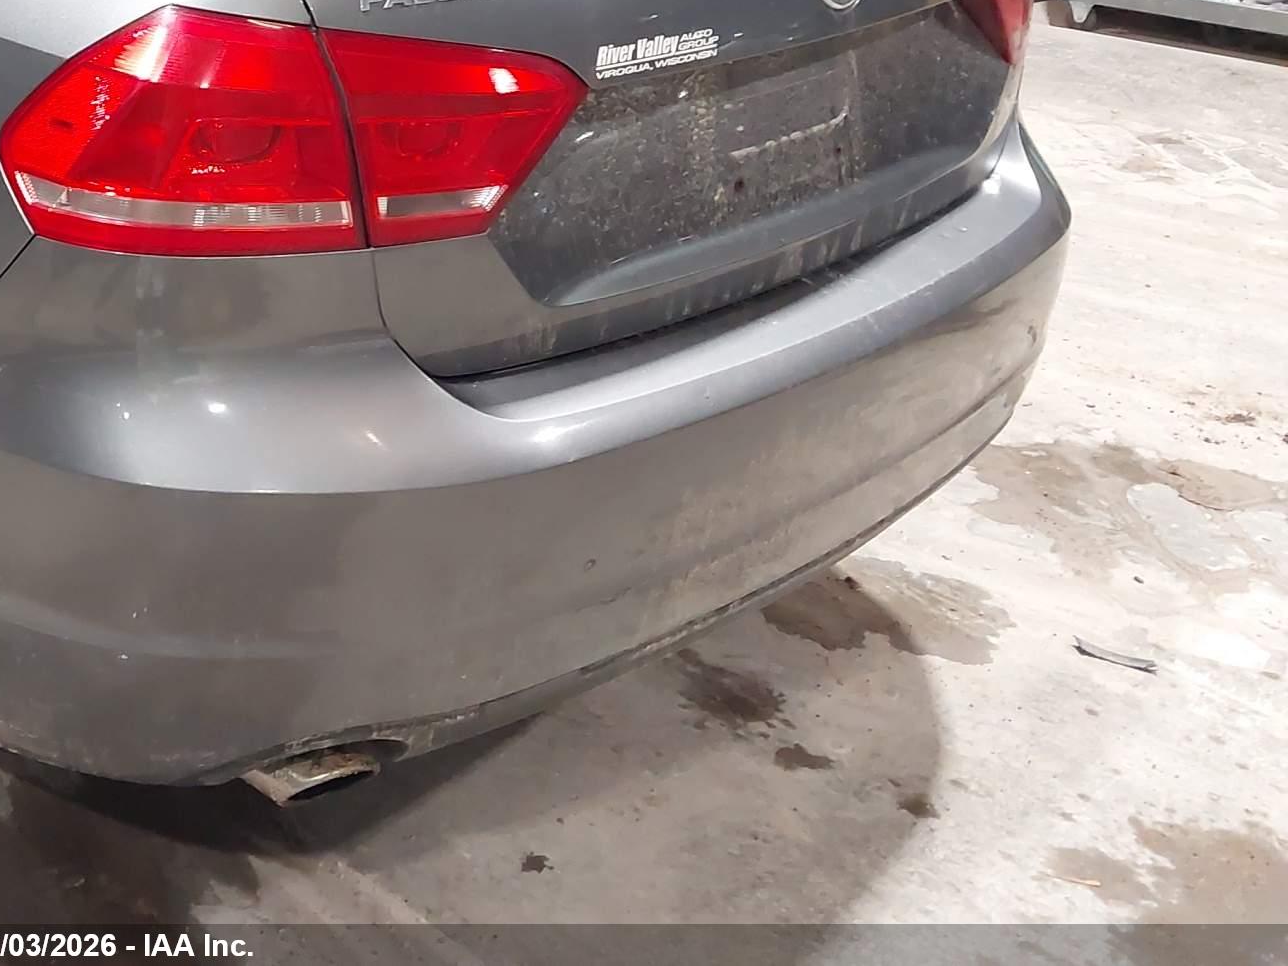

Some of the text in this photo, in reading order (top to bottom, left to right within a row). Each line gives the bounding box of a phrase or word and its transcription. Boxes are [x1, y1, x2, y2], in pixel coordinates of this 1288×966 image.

[678, 35, 719, 50] GROUP
[680, 28, 713, 42] AUTO
[596, 34, 680, 67] River Valley
[595, 49, 719, 80] VIROQUA, WISCONSIN
